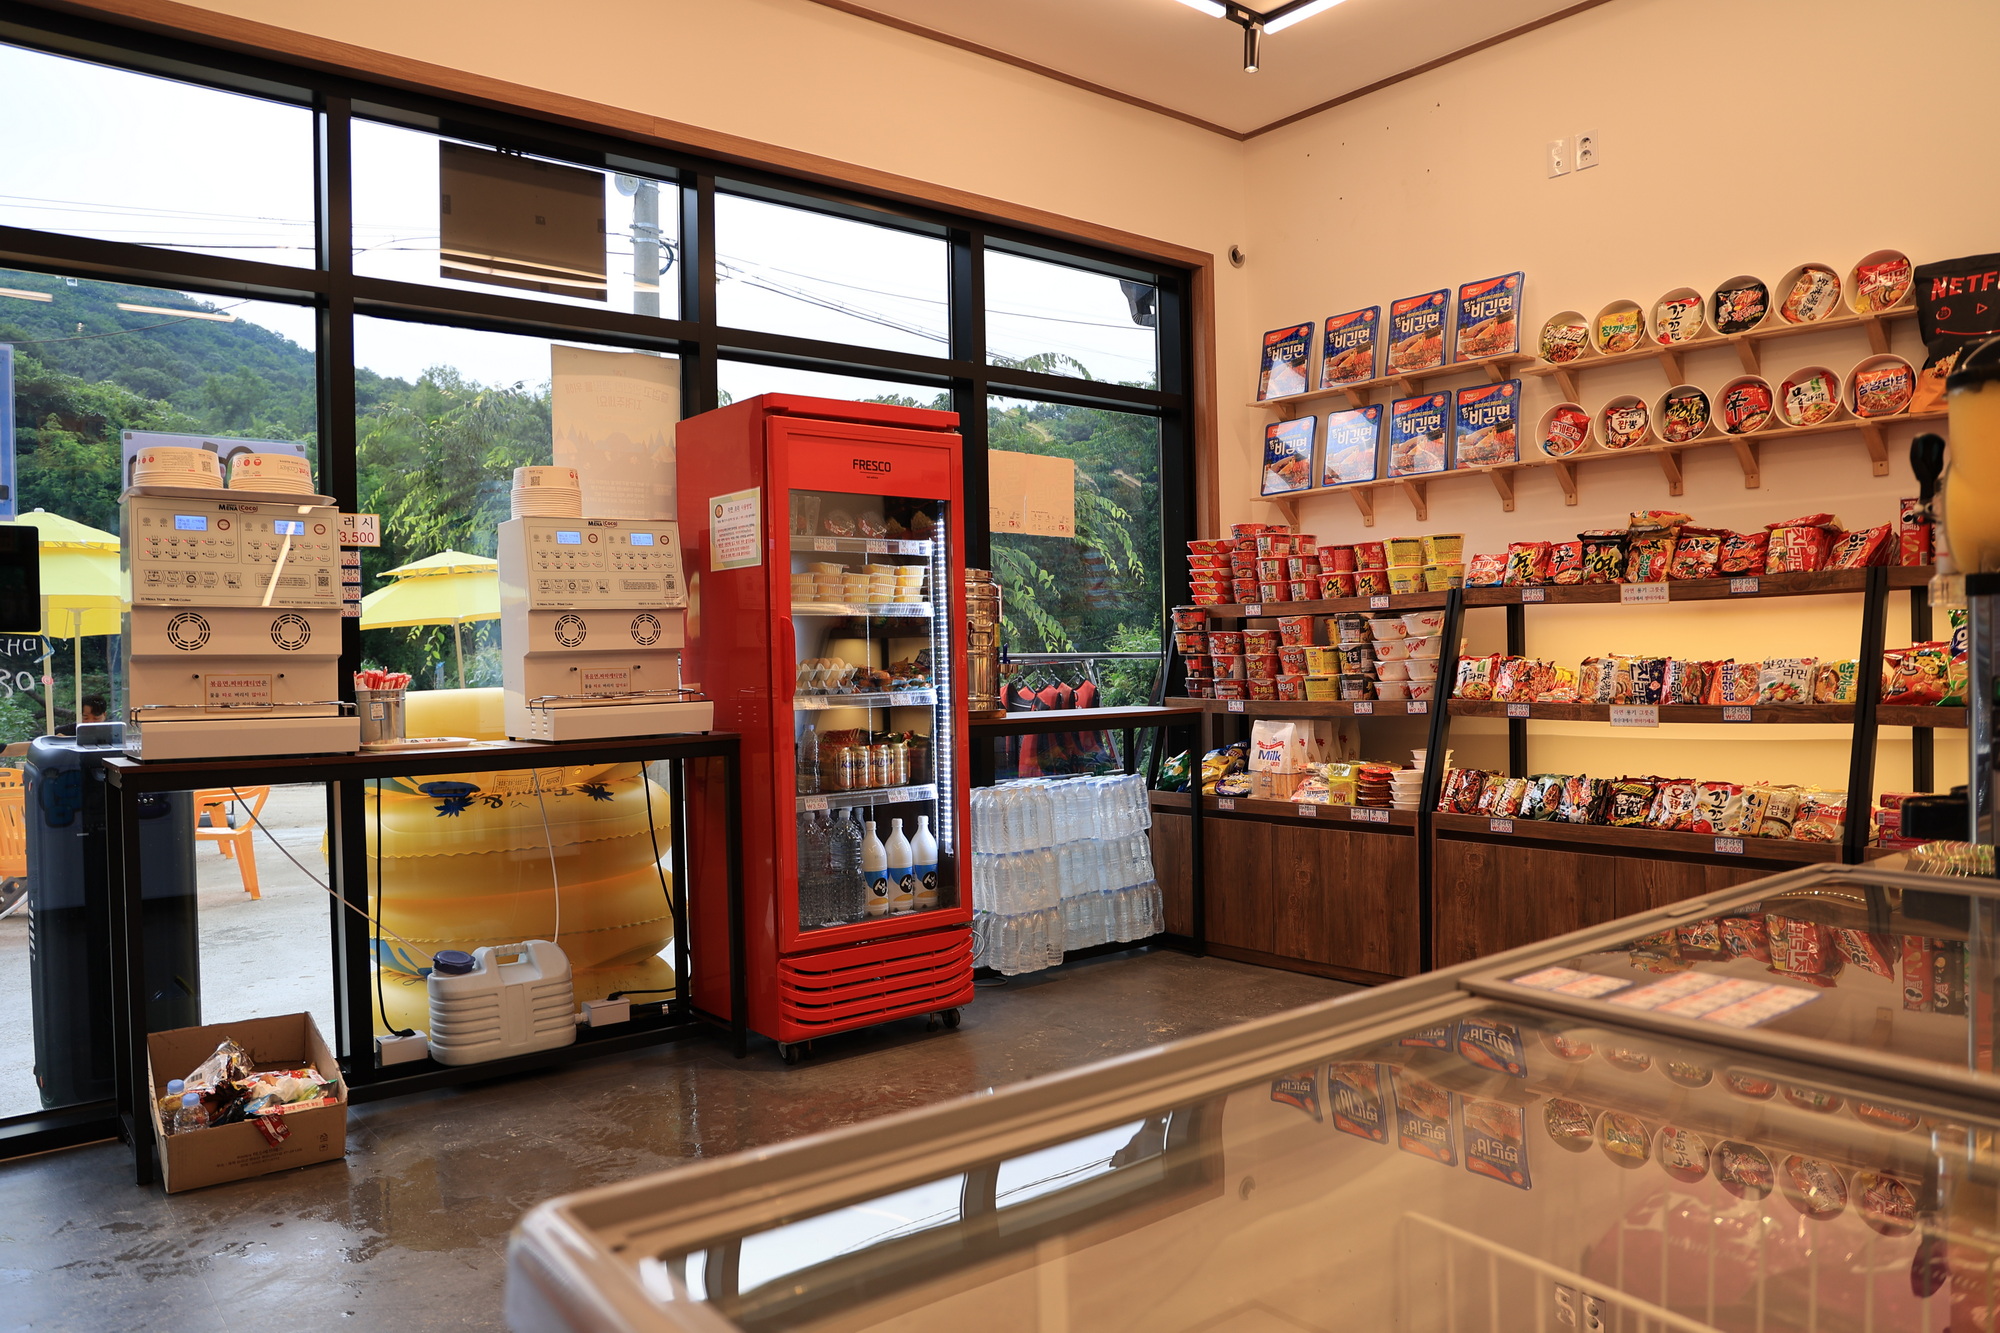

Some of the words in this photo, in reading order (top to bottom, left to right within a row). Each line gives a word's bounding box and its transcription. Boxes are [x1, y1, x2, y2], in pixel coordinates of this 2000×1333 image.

[1931, 271, 2000, 301] NETF
[1471, 296, 1512, 317] 비김면
[1401, 312, 1439, 333] 비김면
[1602, 323, 1637, 338] 참깨라면
[1667, 303, 1687, 341] 꼬꼬면
[1859, 375, 1907, 396] 삼양라면
[1469, 404, 1510, 425] 비김면
[1727, 390, 1748, 421] 辛
[1403, 414, 1440, 434] 비김면
[1338, 426, 1372, 444] 비김면
[1274, 437, 1307, 455] 비김면
[852, 459, 892, 472] FRESCO
[344, 516, 355, 528] 러
[362, 516, 373, 529] 시
[340, 532, 374, 543] 3,500
[1784, 527, 1807, 572] 진라면
[1512, 552, 1534, 579] 열
[1763, 658, 1799, 670] 맛있는
[1784, 668, 1808, 680] 라면
[1722, 663, 1734, 702] 삼양라면
[1258, 750, 1281, 761] Milk
[1708, 790, 1730, 832] 꼬꼬면
[1769, 804, 1791, 818] 짬뽕
